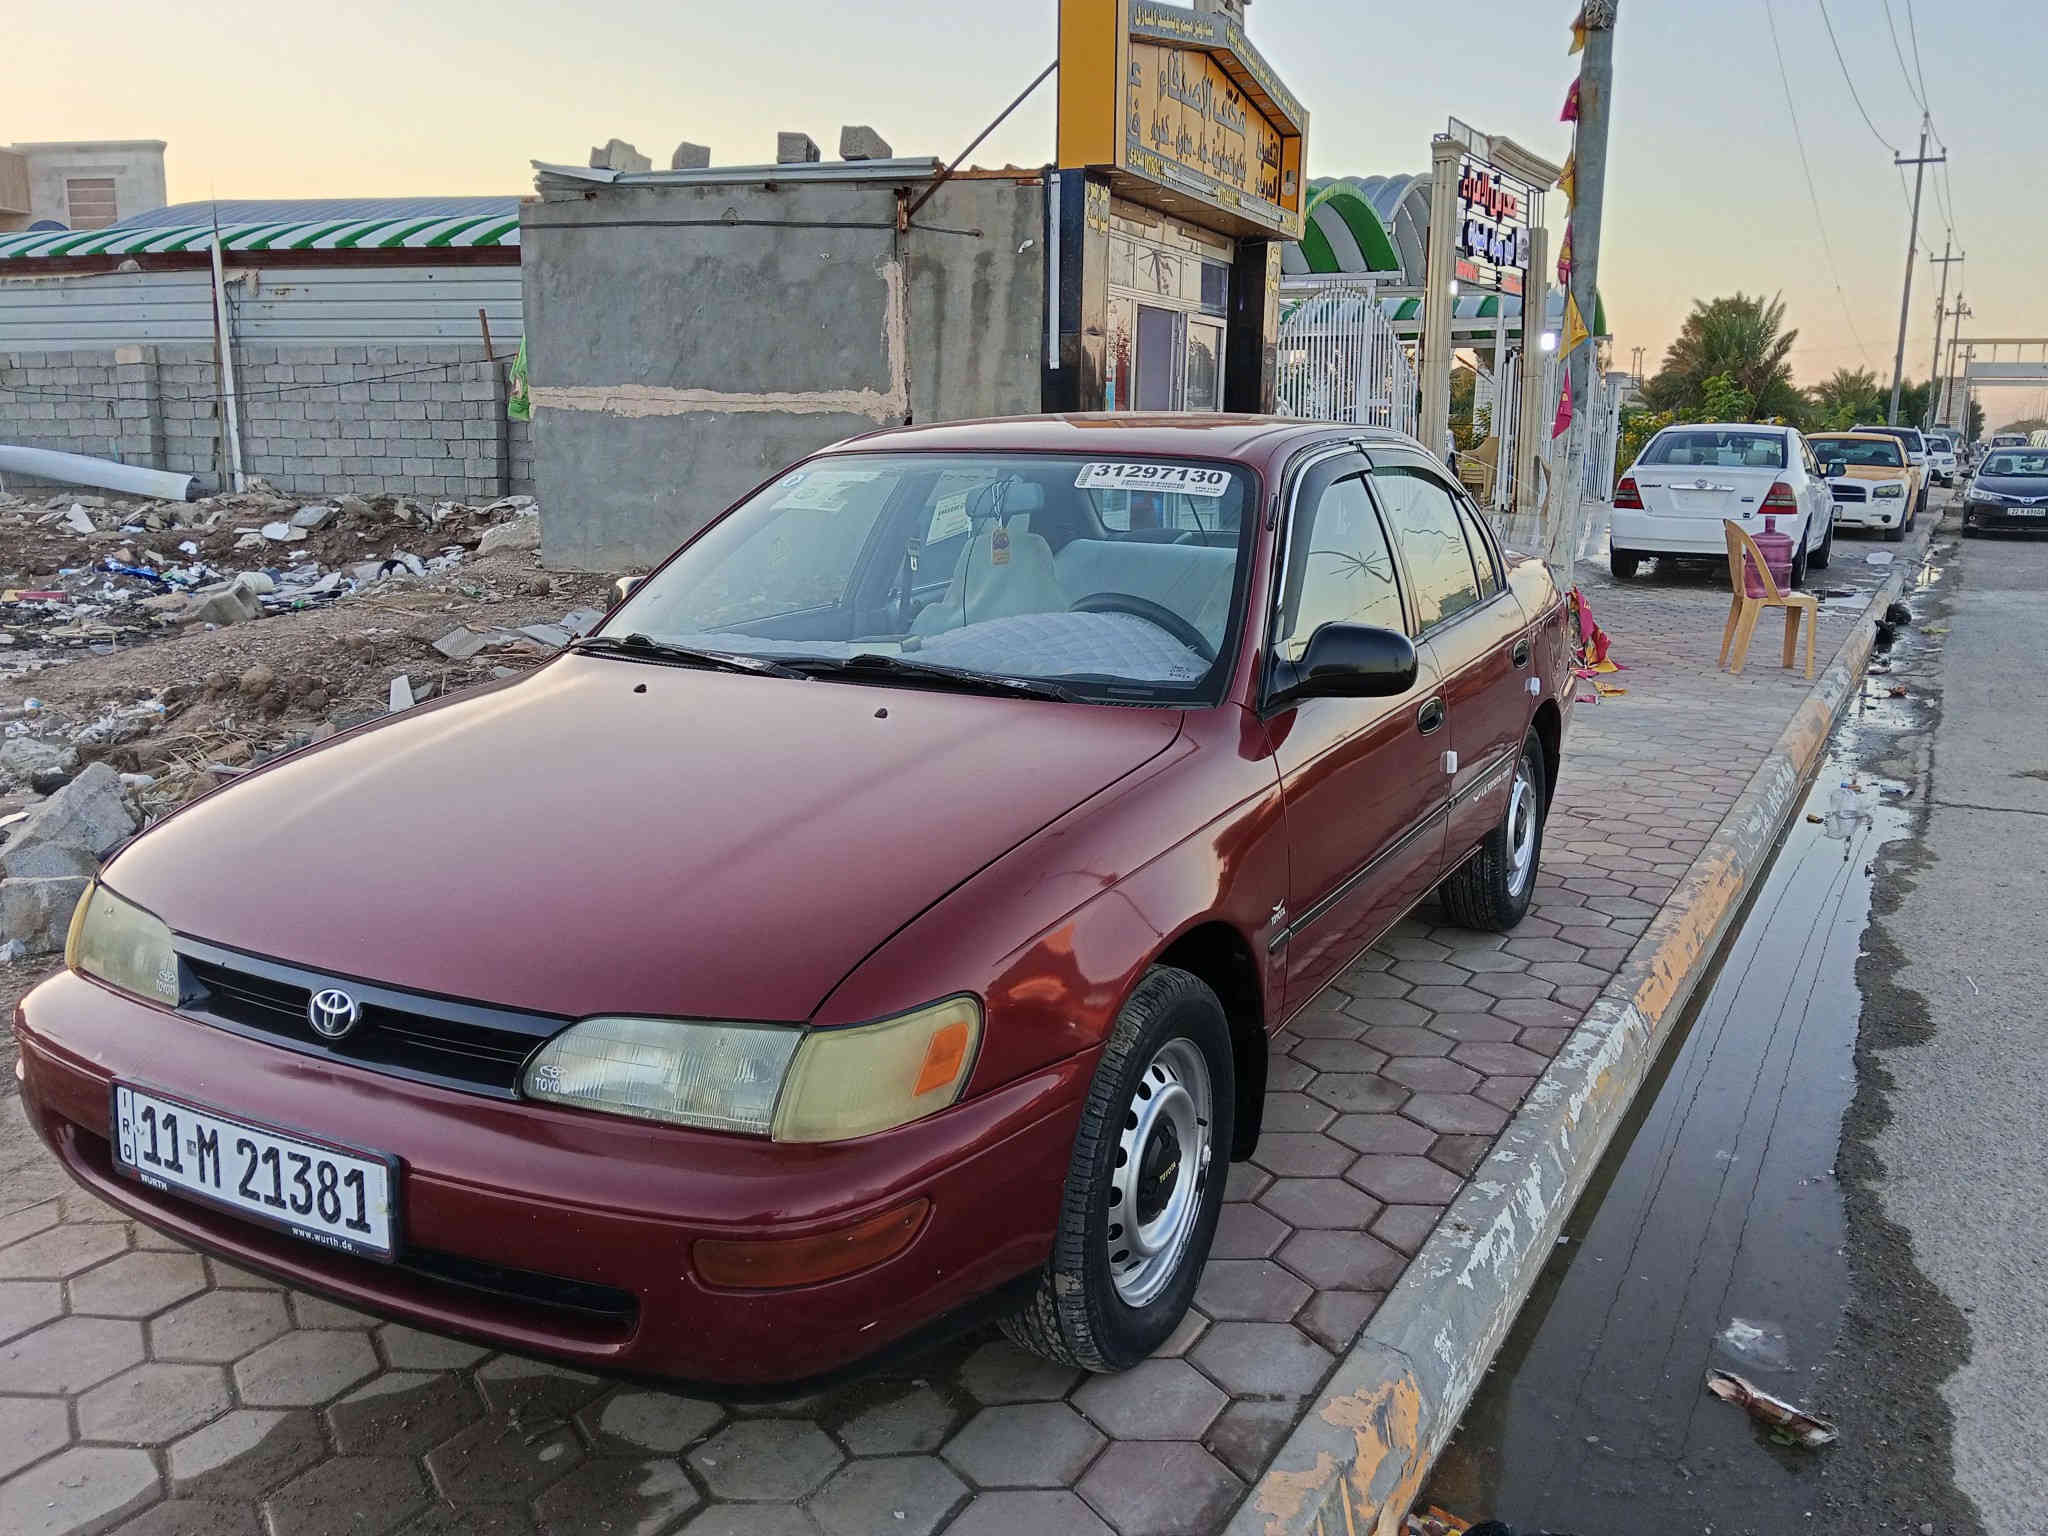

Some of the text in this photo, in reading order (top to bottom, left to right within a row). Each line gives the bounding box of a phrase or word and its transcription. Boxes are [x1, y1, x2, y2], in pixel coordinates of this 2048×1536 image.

[1213, 88, 1246, 136] مكتب
[1094, 464, 1224, 486] 31297130
[141, 1105, 183, 1174] 11
[196, 1123, 221, 1188] M
[236, 1138, 372, 1234] 21381
